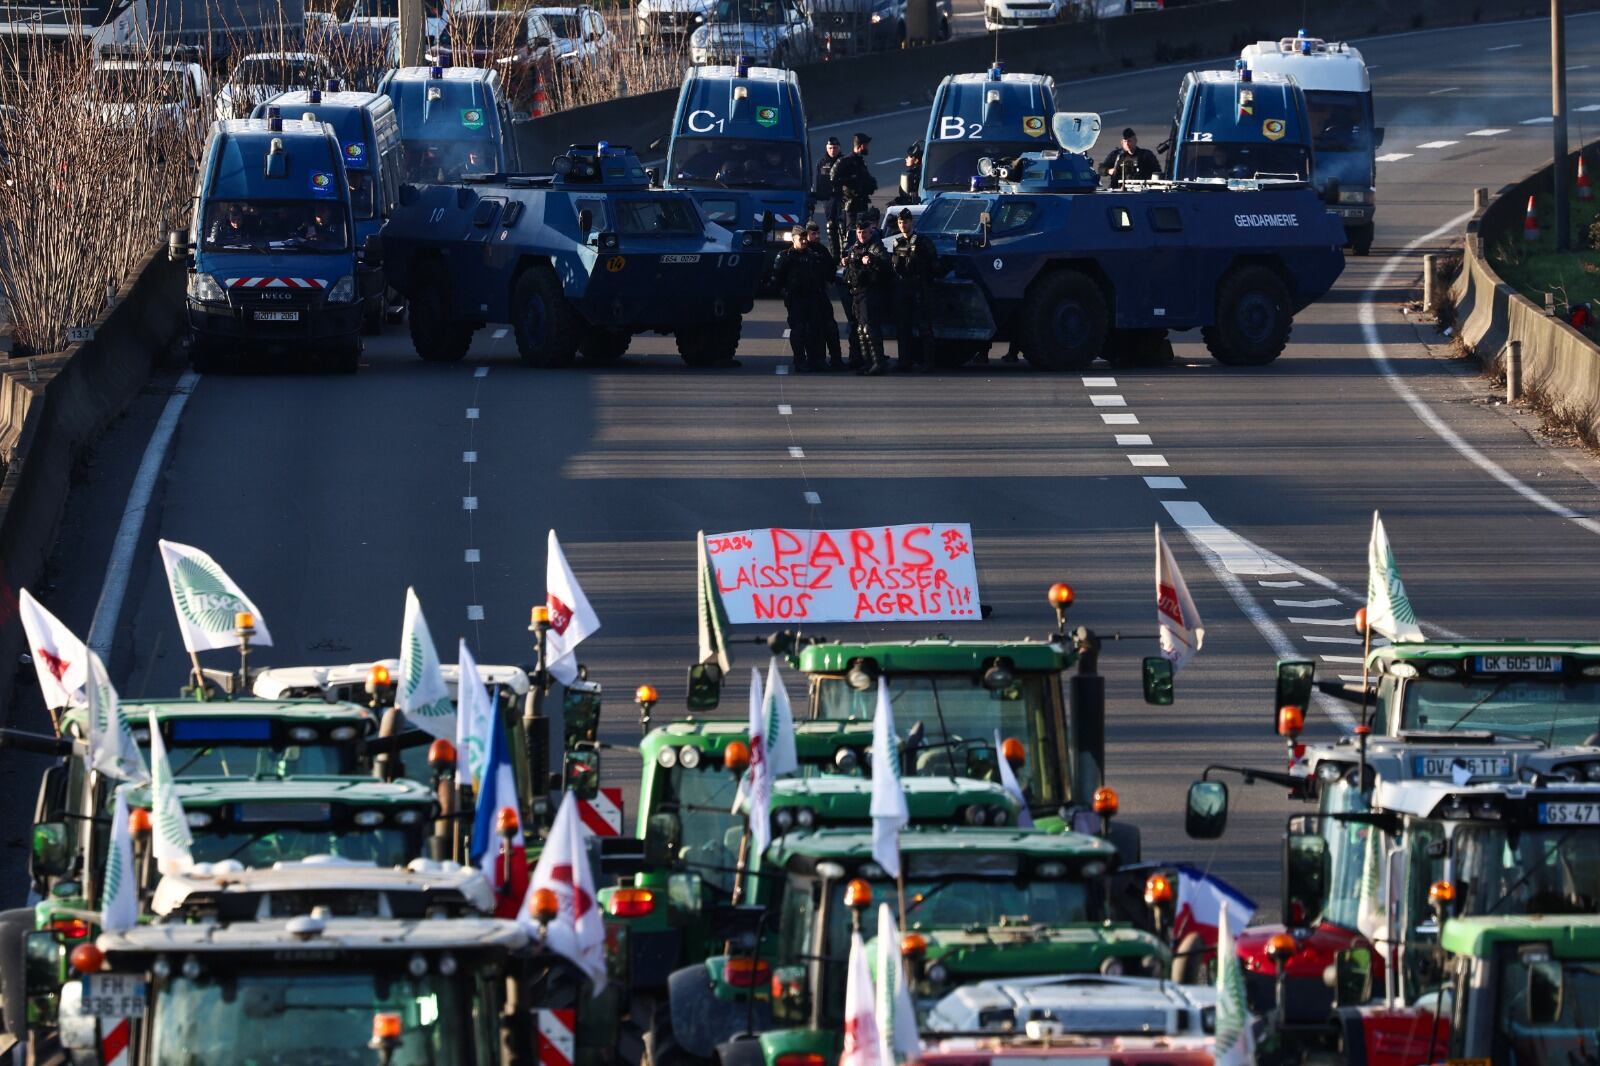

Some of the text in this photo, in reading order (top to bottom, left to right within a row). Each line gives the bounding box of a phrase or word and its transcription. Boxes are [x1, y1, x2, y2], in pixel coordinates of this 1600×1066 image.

[940, 116, 983, 139] B2
[1234, 214, 1299, 227] GENDARMERIE
[71, 330, 90, 339] 13.7
[769, 527, 935, 569] PARIS
[849, 565, 955, 591] PASSER
[752, 592, 813, 619] NOS
